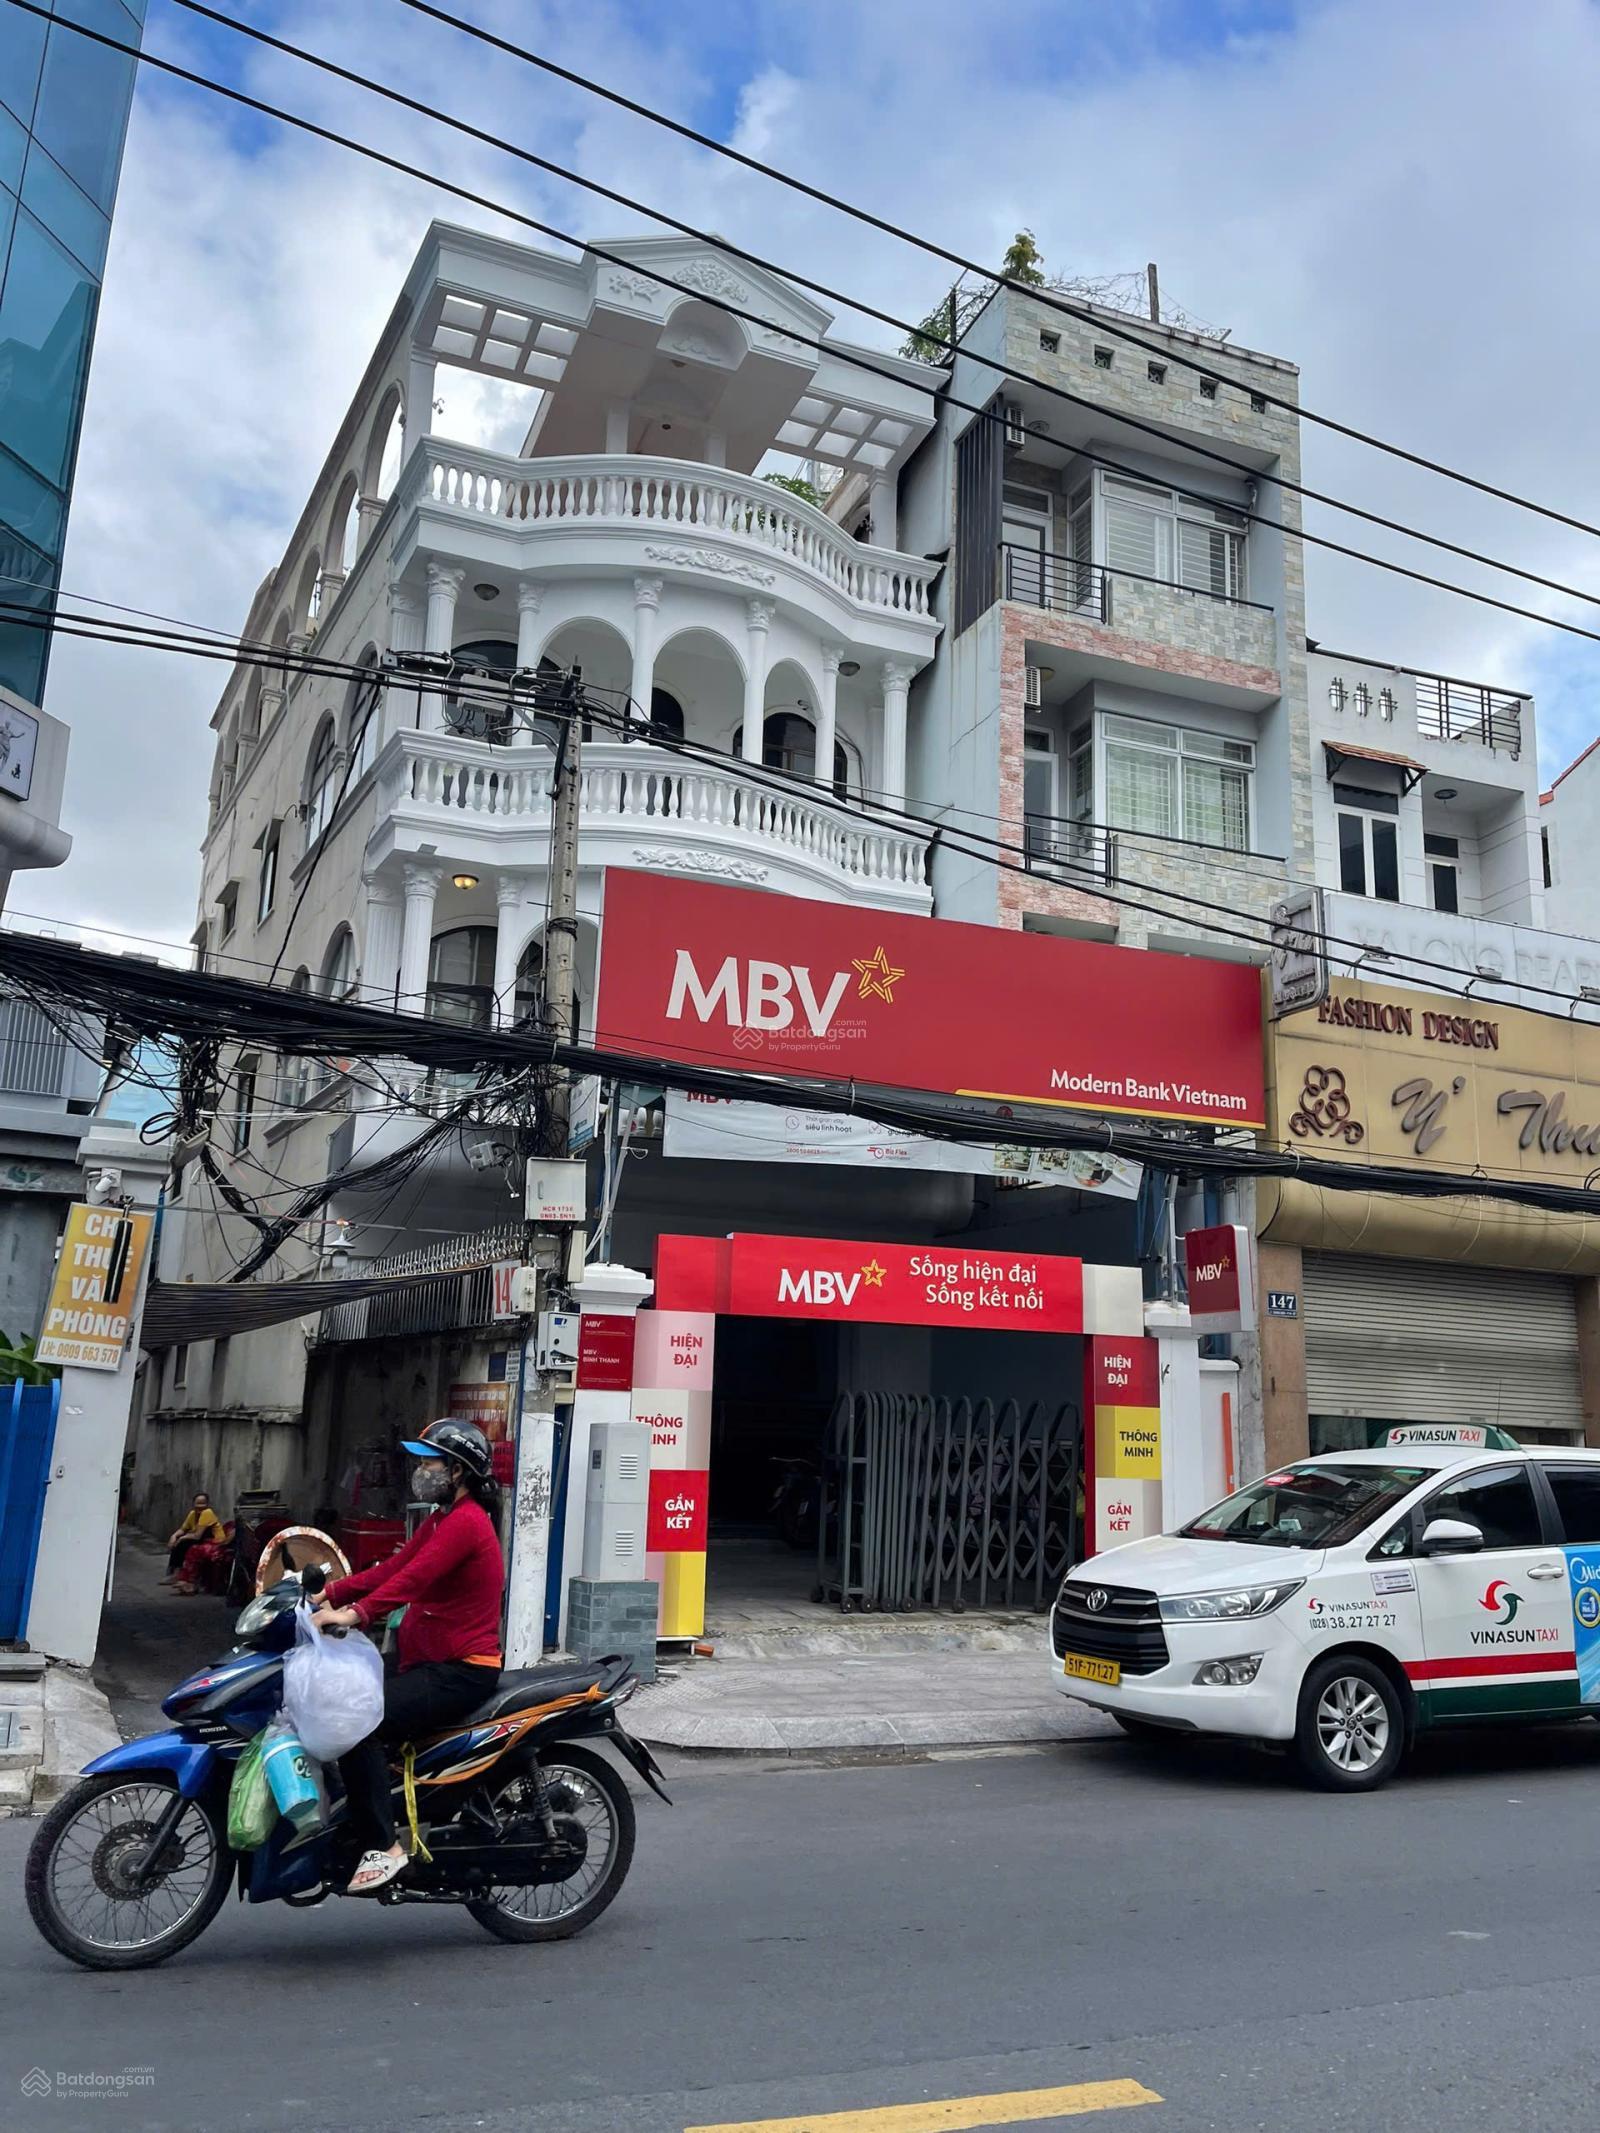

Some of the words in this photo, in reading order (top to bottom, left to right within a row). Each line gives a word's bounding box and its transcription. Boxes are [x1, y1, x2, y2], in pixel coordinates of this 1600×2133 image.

[666, 949, 851, 1037] MBV
[1318, 995, 1412, 1036] FASHION
[1422, 1011, 1499, 1051] DESIGN
[1050, 1069, 1122, 1096] Modern
[1125, 1078, 1170, 1101] Bank
[1171, 1084, 1247, 1110] Vietnam
[778, 1269, 861, 1305] MBV
[910, 1255, 958, 1284] Sống
[963, 1259, 1003, 1284] hiện
[1008, 1264, 1036, 1286] đại
[1196, 1263, 1222, 1282] MBV
[71, 1273, 106, 1303] VĂ
[926, 1282, 974, 1311] Sống
[979, 1285, 1009, 1308] kết
[1014, 1288, 1043, 1310] nối
[1271, 1295, 1295, 1309] 147
[47, 1307, 128, 1339] PHÒNG
[670, 1333, 703, 1350] HIỆN
[57, 1343, 80, 1359] 0909
[673, 1353, 698, 1368] ĐẠI
[1104, 1354, 1132, 1371] HIỆN
[1107, 1373, 1128, 1388] ĐẠI
[650, 1434, 677, 1445] INH
[1119, 1429, 1158, 1443] THÔNG
[1409, 1430, 1457, 1441] VINASUN
[1459, 1430, 1480, 1441] TAXI
[1124, 1447, 1154, 1457] MINH
[664, 1493, 695, 1512] GẮN
[1107, 1499, 1132, 1515] GẮN
[666, 1512, 693, 1529] KẾT
[1109, 1516, 1130, 1531] KẾT
[1366, 1615, 1379, 1627] 27
[1383, 1614, 1396, 1626] 27
